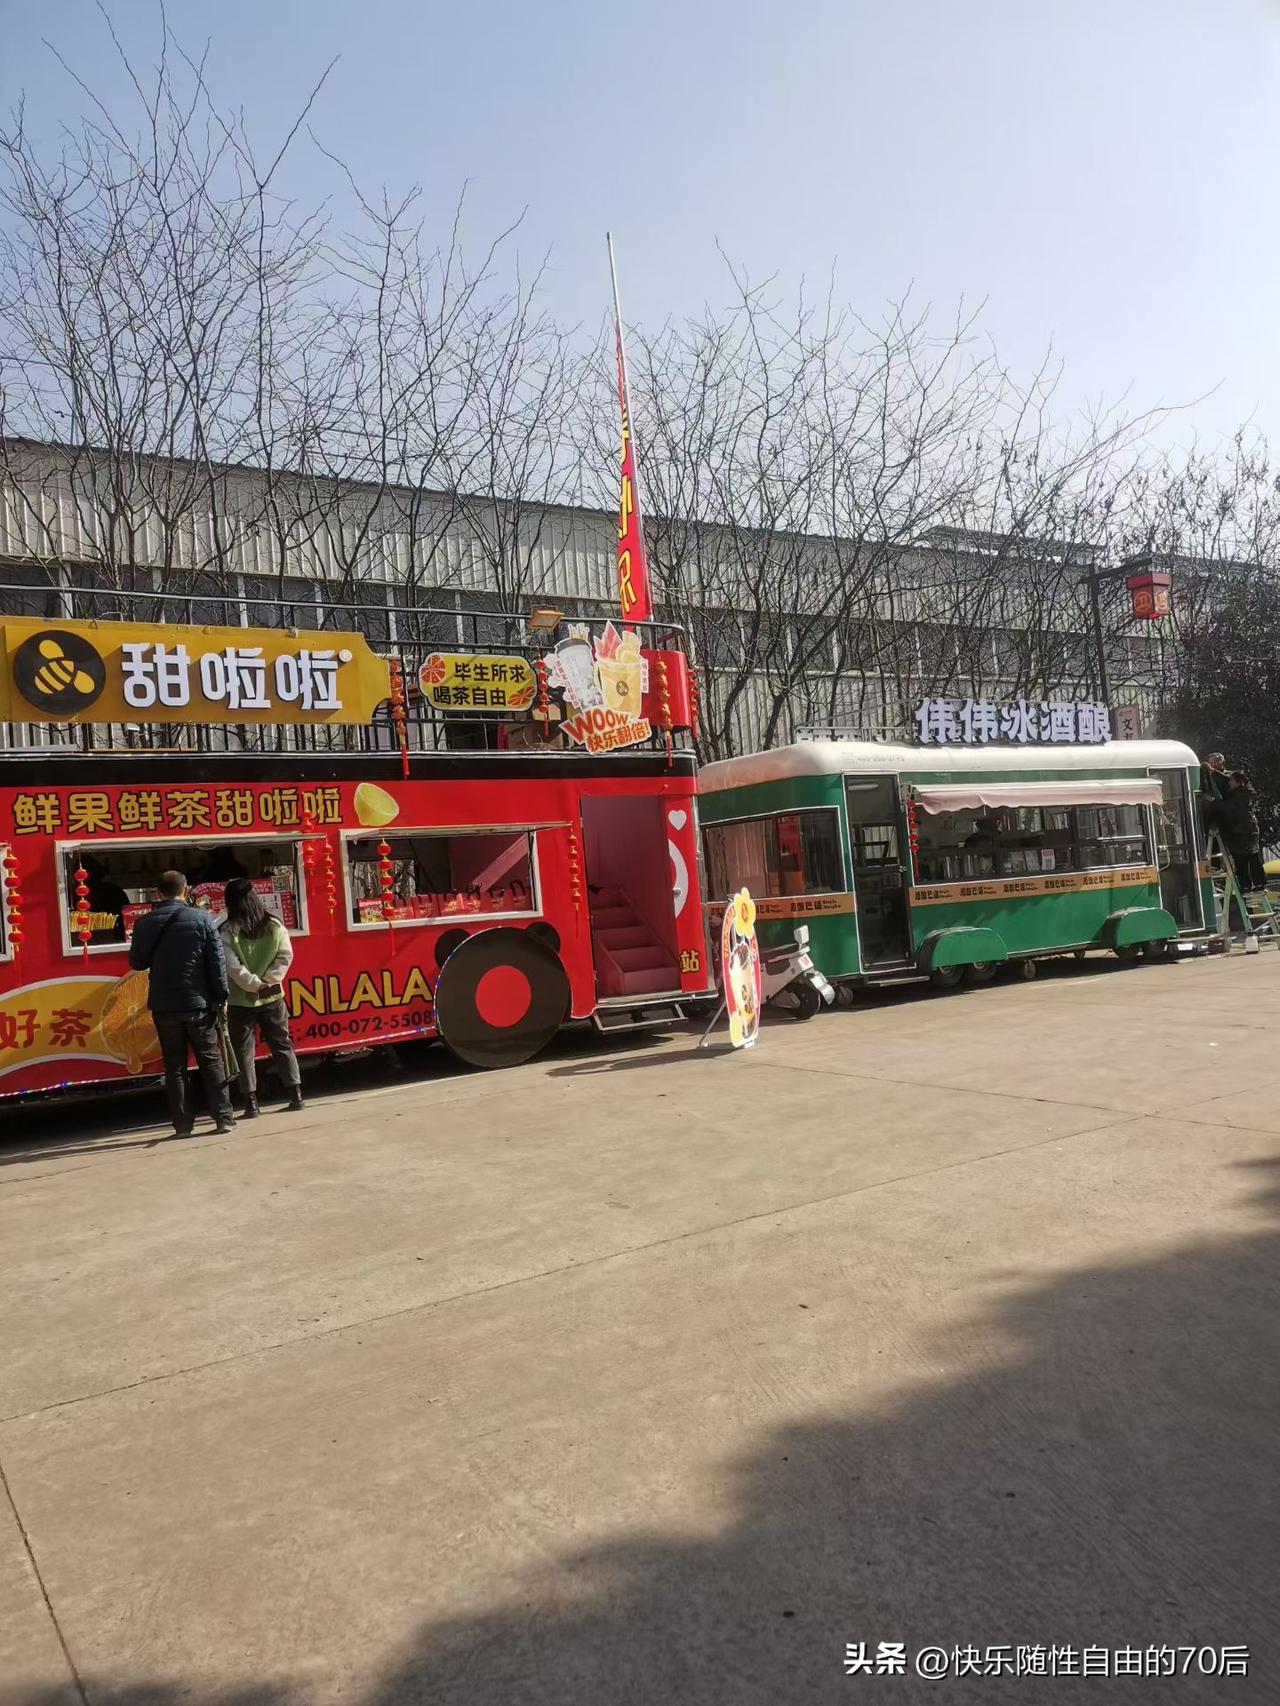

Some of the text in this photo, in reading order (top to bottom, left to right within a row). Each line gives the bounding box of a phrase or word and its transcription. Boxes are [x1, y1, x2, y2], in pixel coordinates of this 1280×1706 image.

[454, 661, 527, 683] 毕生所求
[433, 686, 507, 707] 喝茶自由
[915, 697, 1113, 744] 伟伟冰酒酿
[13, 786, 343, 836] 鲜果鲜茶甜啦啦
[680, 949, 700, 974] 站
[288, 966, 434, 1018] NLALA
[0, 1008, 93, 1049] 好茶
